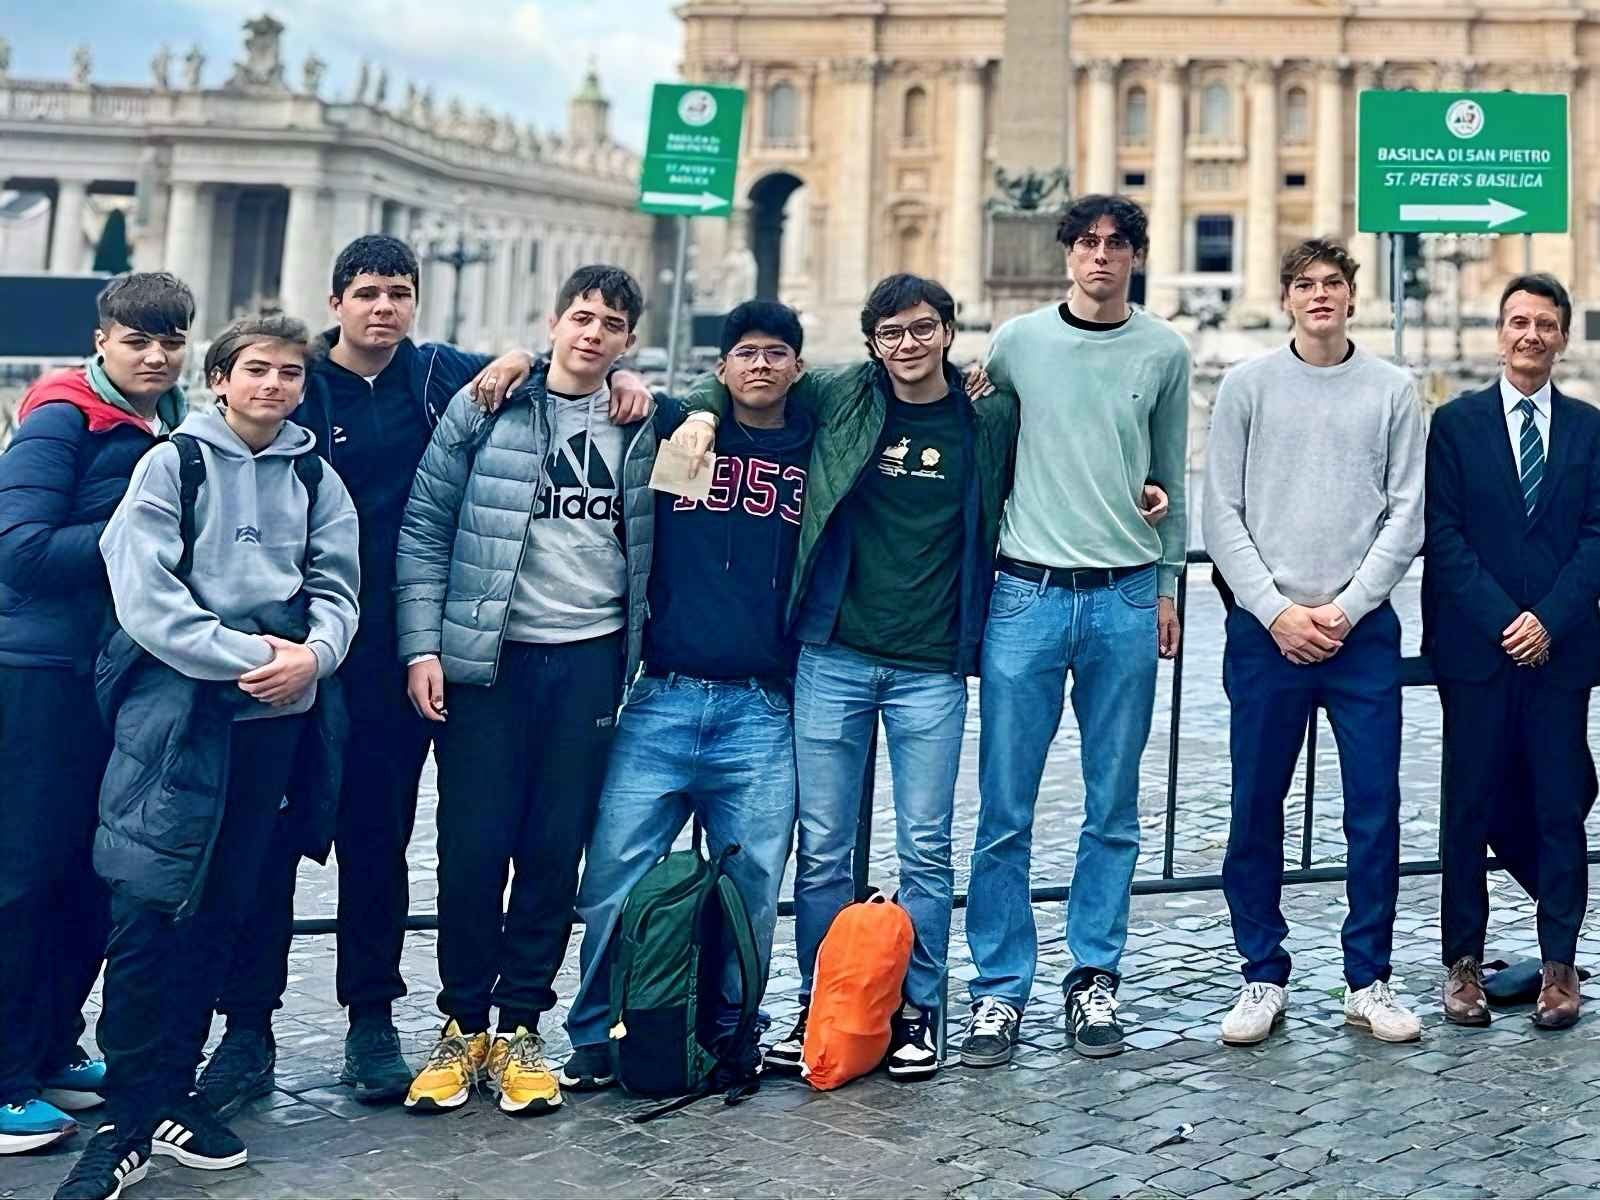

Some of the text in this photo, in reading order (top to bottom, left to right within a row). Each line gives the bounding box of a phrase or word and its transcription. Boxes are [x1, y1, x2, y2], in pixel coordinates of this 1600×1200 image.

[1378, 147, 1551, 163] BASILICA DI SAN PIETRO
[1384, 172, 1544, 188] ST. PETER'S BASILICA
